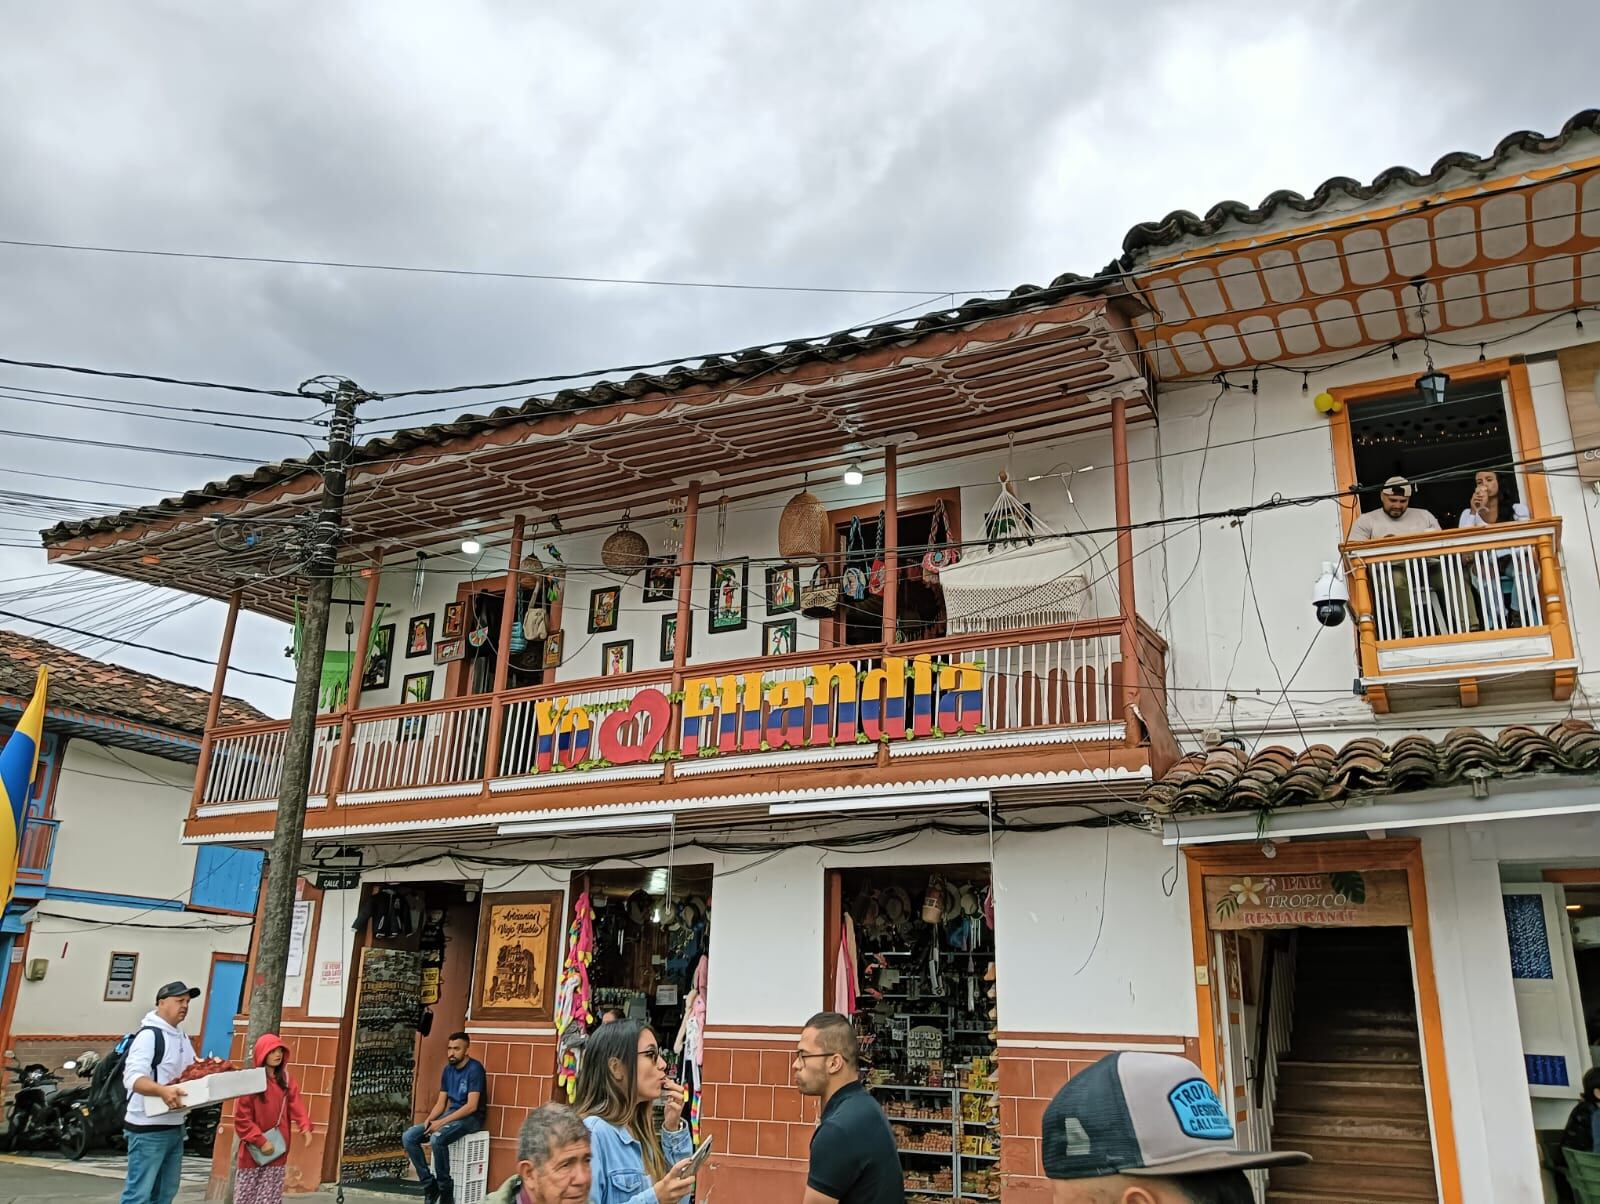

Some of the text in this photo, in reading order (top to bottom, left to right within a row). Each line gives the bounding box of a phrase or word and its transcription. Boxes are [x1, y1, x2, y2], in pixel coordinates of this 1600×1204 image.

[535, 697, 590, 772] Yo
[323, 879, 340, 888] CALLE
[1281, 876, 1322, 890] BAR
[1265, 893, 1347, 909] TROPICO
[1243, 909, 1358, 925] RESTAURANTE
[516, 923, 539, 934] Pueblo
[1174, 1083, 1207, 1108] TROY
